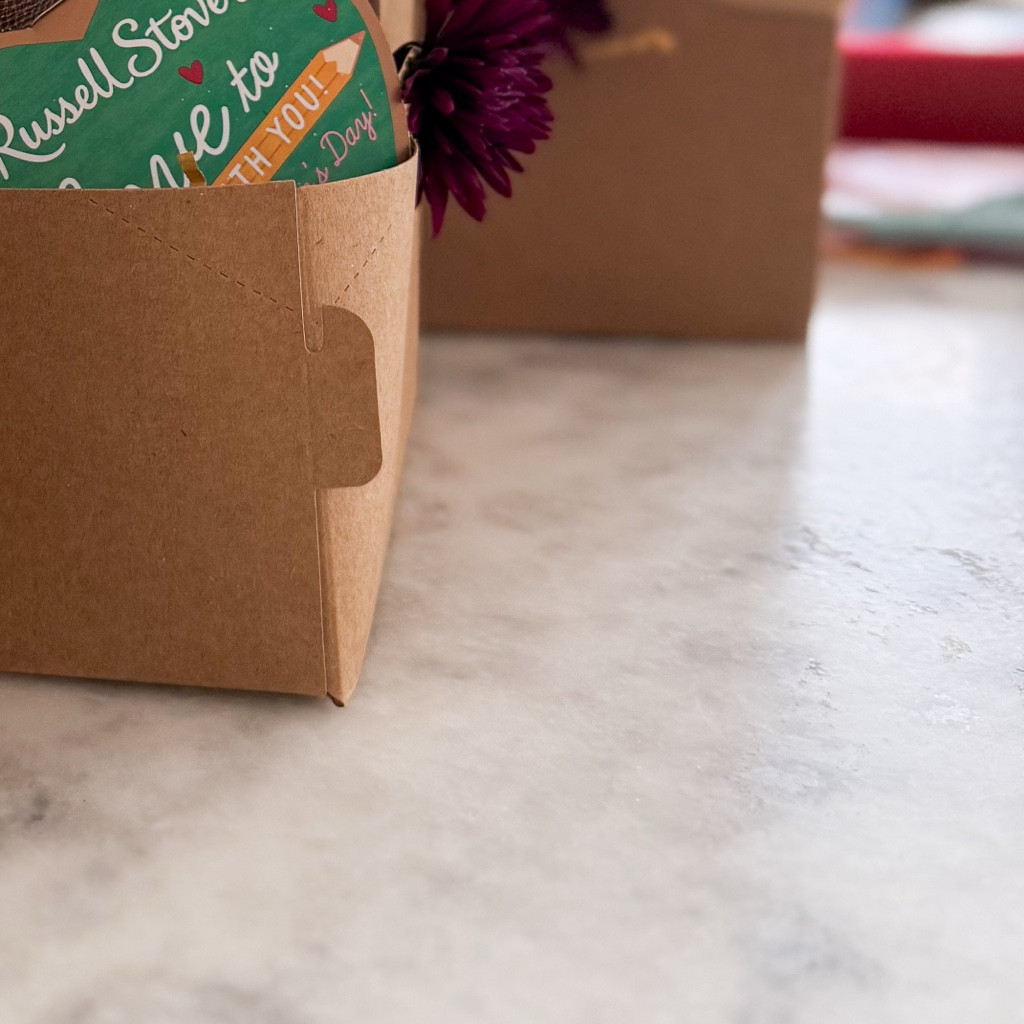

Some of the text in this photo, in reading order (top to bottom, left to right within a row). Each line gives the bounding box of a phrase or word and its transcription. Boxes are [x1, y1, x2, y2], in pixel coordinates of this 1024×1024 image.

[226, 50, 279, 113] to
[265, 74, 329, 145] YOU!
[319, 88, 378, 167] Day!
